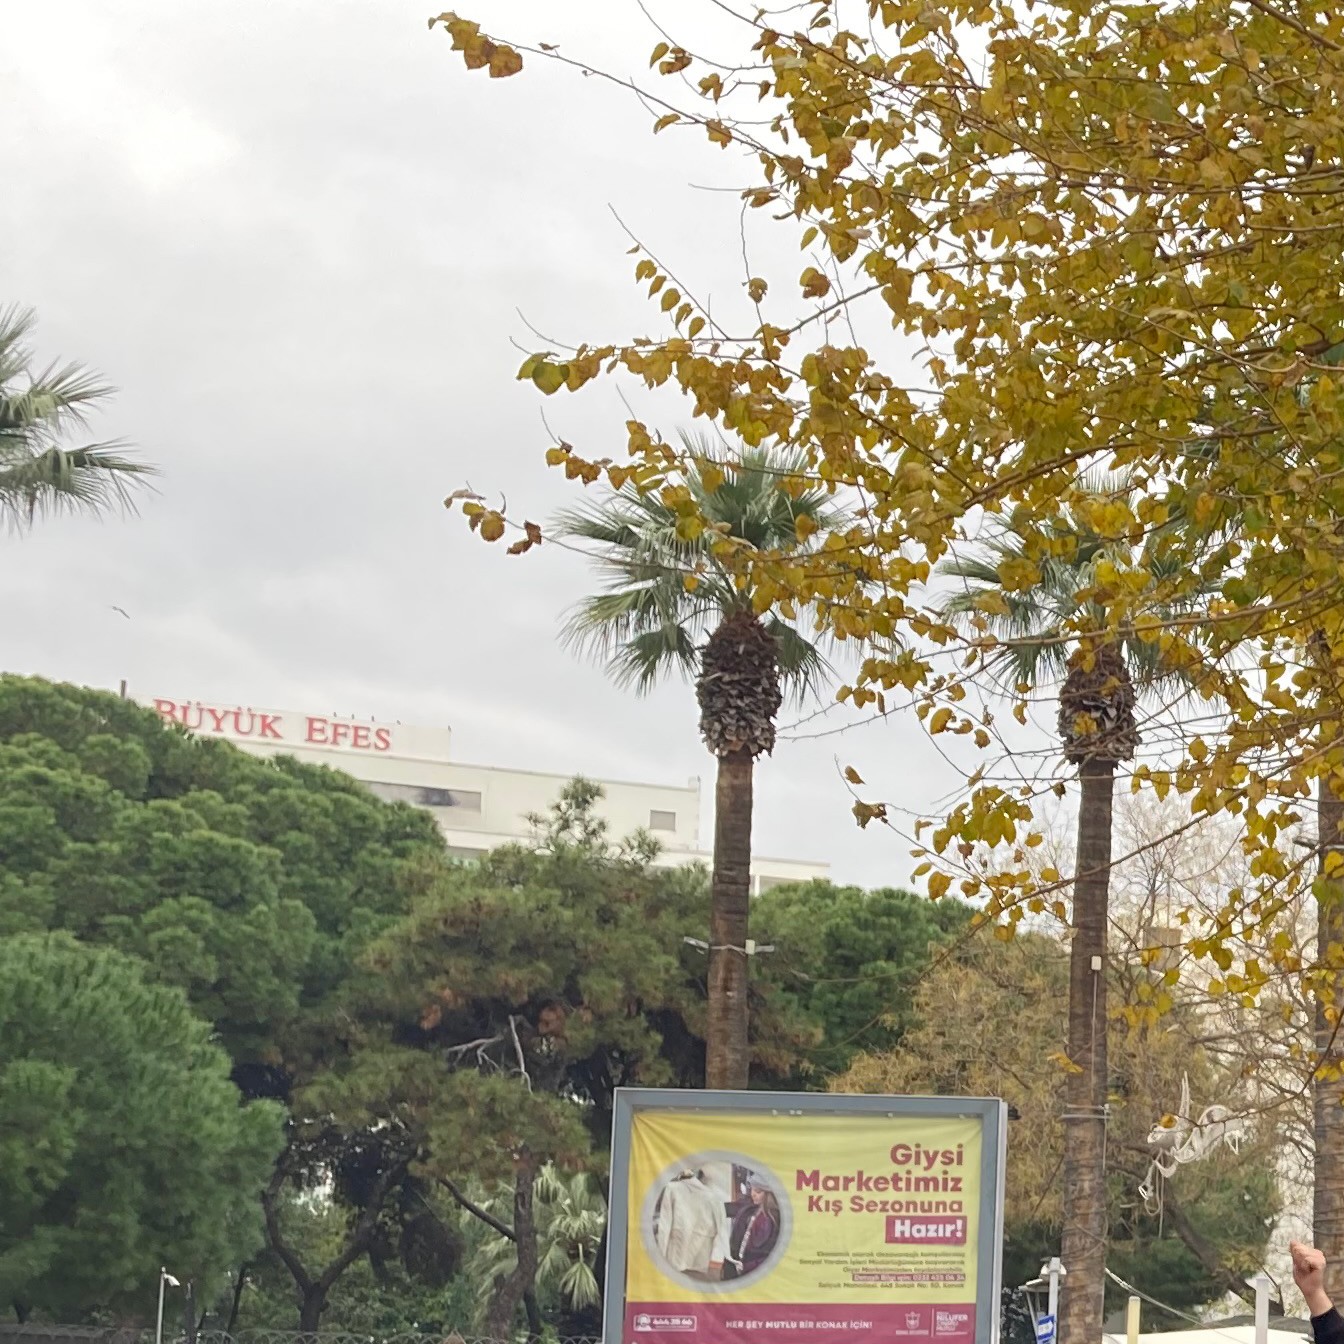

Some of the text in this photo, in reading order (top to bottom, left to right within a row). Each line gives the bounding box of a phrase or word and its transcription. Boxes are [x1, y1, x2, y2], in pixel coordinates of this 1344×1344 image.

[153, 698, 391, 751] BÜYÜK EFES
[890, 1143, 964, 1171] Giysi
[796, 1169, 963, 1192] Marketimiz
[808, 1195, 963, 1216] Kış Sezonuna
[894, 1219, 963, 1238] Hazır!
[725, 1320, 744, 1329] HER
[765, 1320, 797, 1329] MUTLU
[799, 1319, 814, 1329] BİR
[816, 1320, 848, 1329] KONAK
